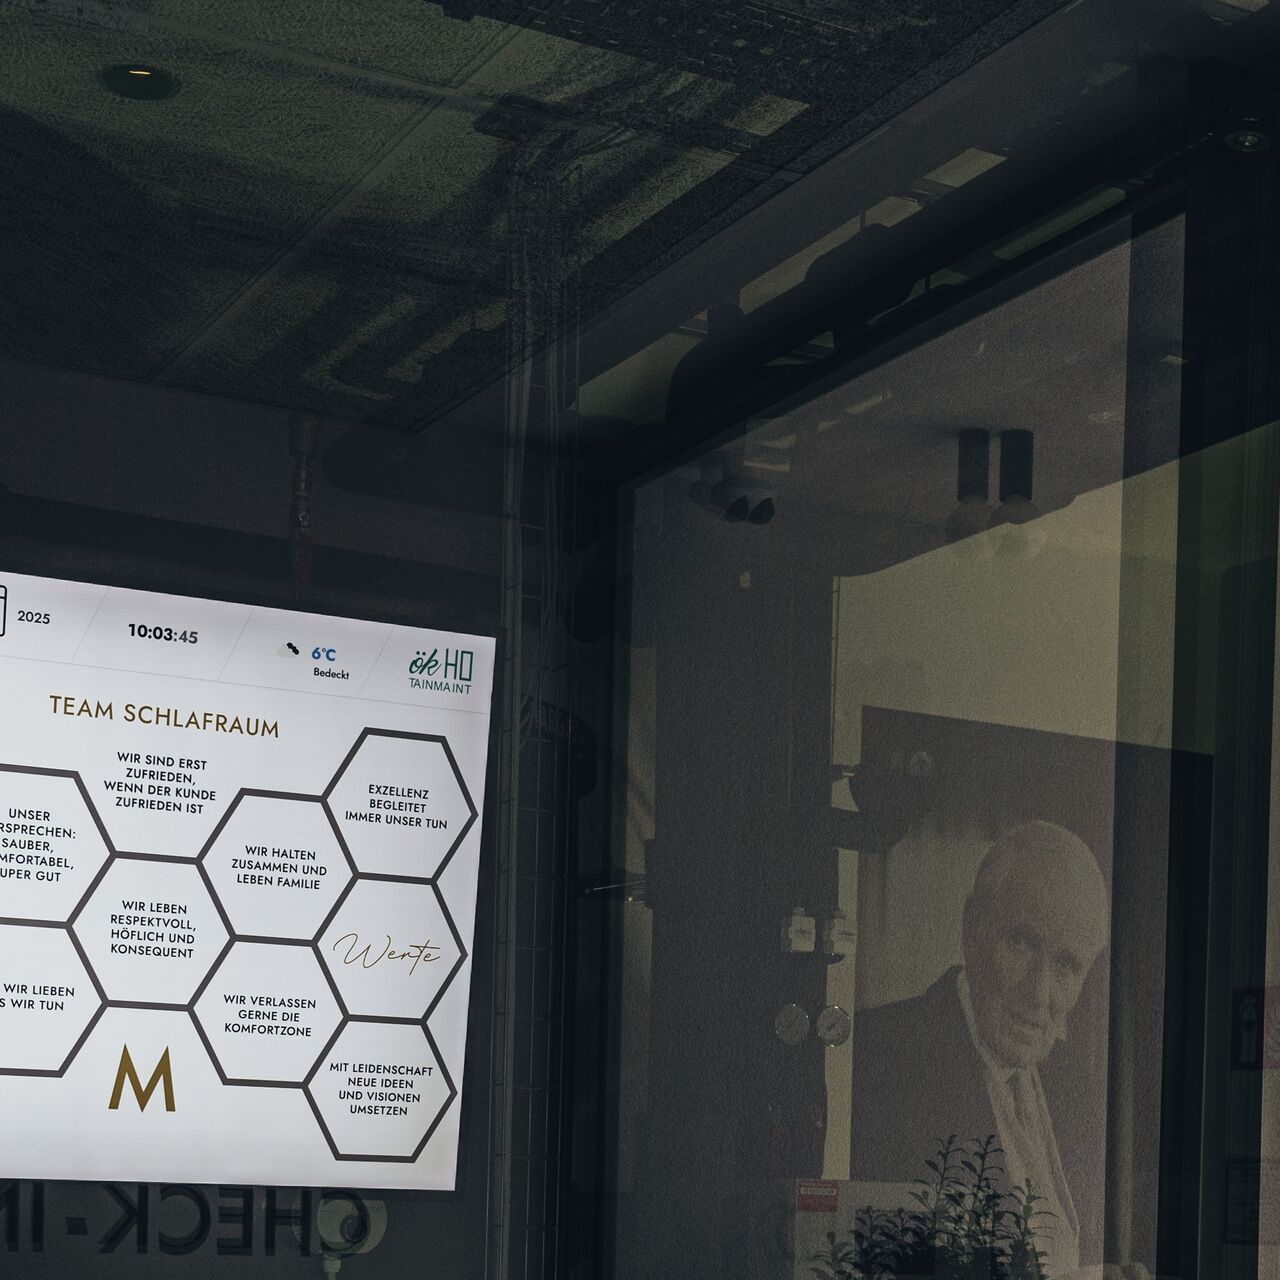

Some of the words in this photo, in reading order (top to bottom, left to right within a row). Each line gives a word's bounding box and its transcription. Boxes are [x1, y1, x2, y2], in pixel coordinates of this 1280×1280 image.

[17, 610, 50, 625] 2025
[128, 623, 198, 645] 10:03:45
[311, 646, 337, 663] 6°C
[313, 666, 349, 681] Bedeckt
[408, 677, 472, 695] TAINMAINT
[49, 695, 113, 720] TEAM
[123, 703, 280, 739] SCHLAFRAUM
[117, 752, 141, 764] WIR
[145, 753, 171, 767] SIND
[175, 757, 207, 770] ERST
[126, 767, 196, 786] ZUFRIEDEN,
[104, 779, 139, 793] WENN
[143, 783, 167, 797] DER
[171, 786, 216, 802] KUNDE
[368, 784, 429, 800] EXZELLENZ
[115, 797, 179, 812] ZUFRIEDEN
[184, 802, 204, 815] IST
[369, 798, 427, 813] BEGLEITET
[9, 808, 50, 822] UNSER
[345, 811, 380, 824] IMMER
[384, 814, 422, 828] UNSER
[425, 818, 448, 830] TUN
[1, 837, 55, 853] SAUBER,
[244, 845, 268, 858] WIR
[272, 847, 316, 861] HALTEN
[231, 858, 299, 873] ZUSAMMEN
[302, 863, 327, 876] UND
[34, 869, 61, 883] GUT
[236, 873, 273, 887] LEBEN
[278, 876, 321, 890] FAMILIE
[122, 900, 145, 913] WIR
[149, 902, 187, 915] LEBEN
[110, 914, 197, 933] RESPEKTVOLL,
[110, 925, 163, 944] HÖFLICH
[168, 933, 195, 945] UND
[110, 944, 194, 960] KONSEQUENT
[332, 932, 441, 976] Werte
[3, 982, 28, 995] WIR
[32, 984, 75, 997] LIEBEN
[10, 998, 34, 1010] WIR
[38, 999, 64, 1012] TUN
[223, 994, 246, 1006] WIR
[250, 995, 317, 1010] VERLASSEN
[238, 1009, 275, 1022] GERNE
[280, 1010, 301, 1023] DIE
[224, 1022, 312, 1038] KOMFORTZONE
[108, 1043, 176, 1112] M
[329, 1061, 348, 1073] MIT
[352, 1063, 434, 1078] LEIDENSCHAFT
[347, 1076, 377, 1088] NEUE
[380, 1077, 414, 1090] IDEEN
[339, 1089, 363, 1102] UND
[366, 1090, 421, 1104] VISIONEN
[349, 1103, 408, 1117] UMSETZEN
